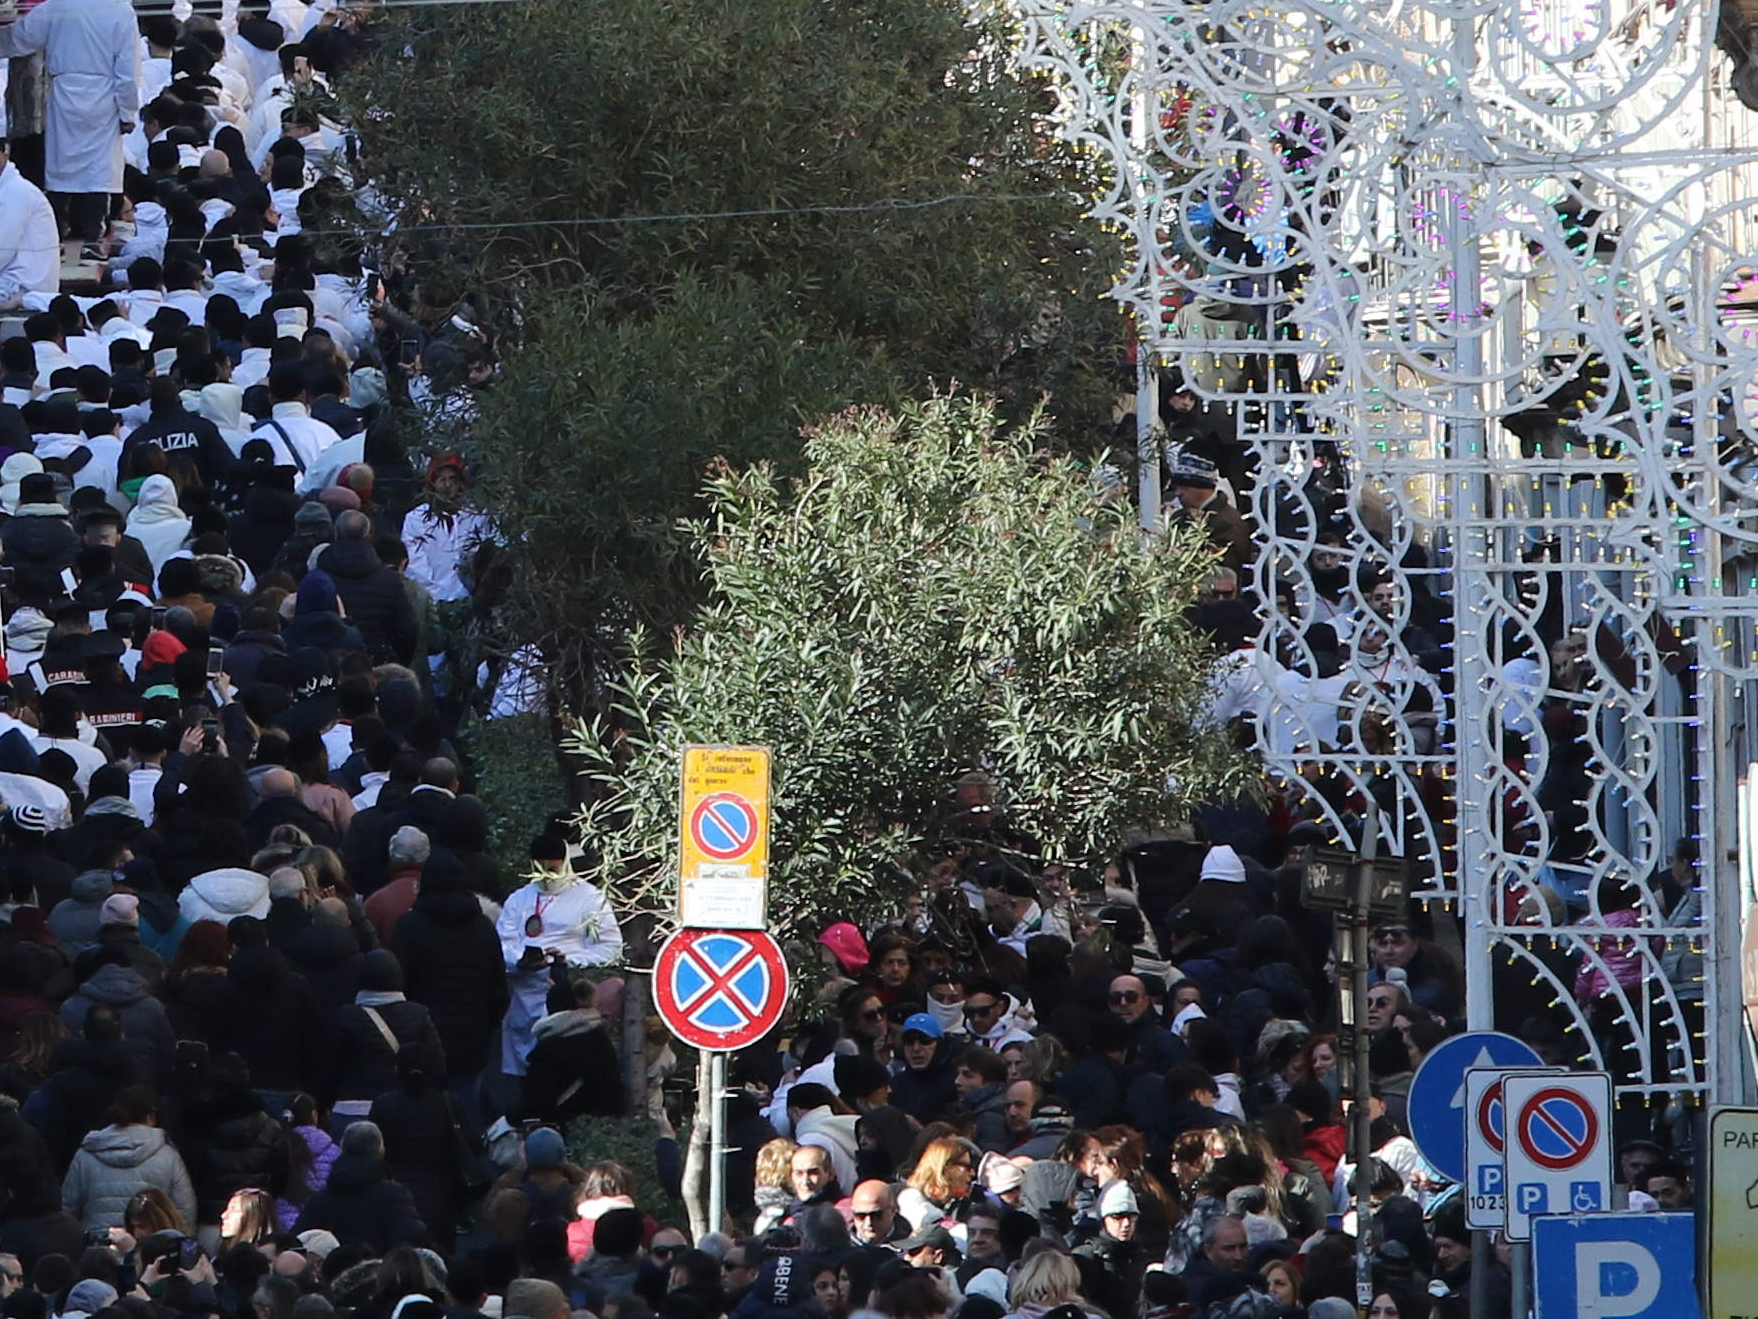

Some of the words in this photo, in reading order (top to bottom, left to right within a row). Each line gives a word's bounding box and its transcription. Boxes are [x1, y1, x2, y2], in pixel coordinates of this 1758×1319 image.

[1483, 1167, 1502, 1192] P
[1522, 1186, 1542, 1210] P
[1575, 1240, 1662, 1319] P
